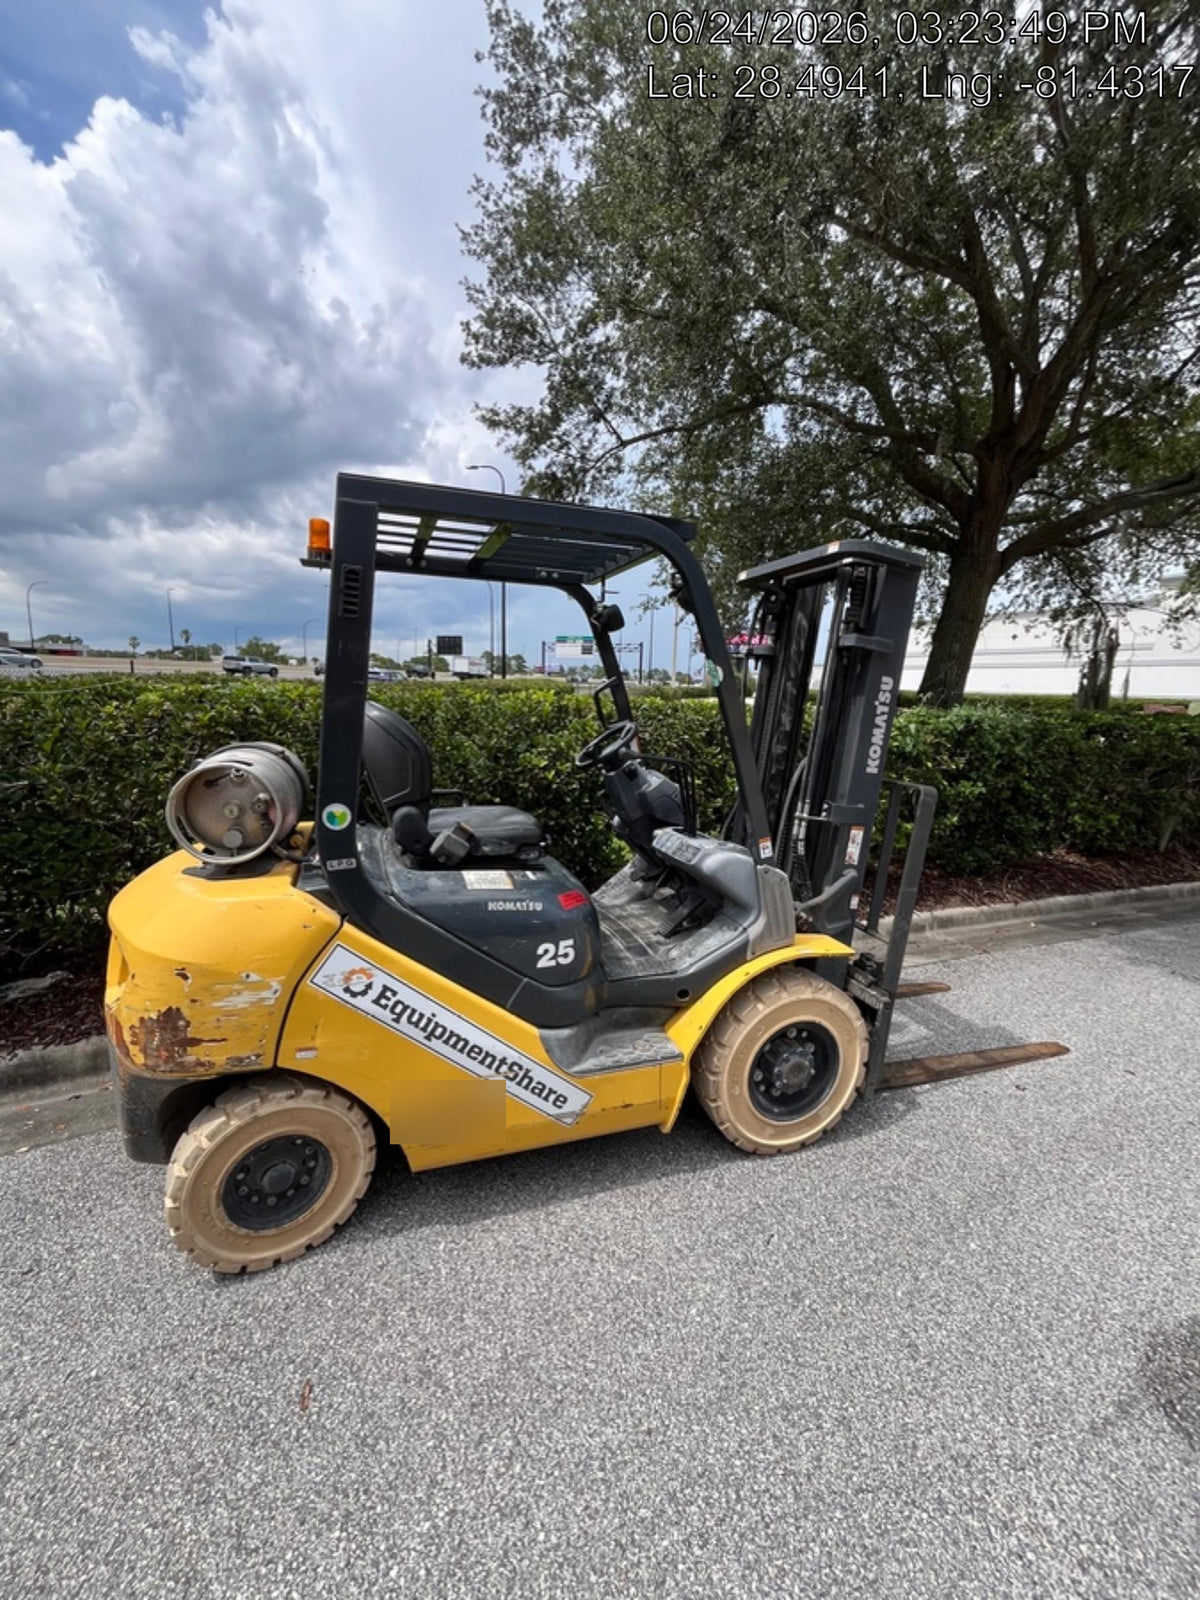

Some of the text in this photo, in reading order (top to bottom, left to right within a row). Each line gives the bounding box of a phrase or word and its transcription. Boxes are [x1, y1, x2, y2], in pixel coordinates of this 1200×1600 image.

[865, 675, 894, 774] KOMATSU
[487, 899, 543, 911] KOMATSU
[536, 938, 575, 968] 25
[371, 984, 568, 1109] EquipmentShare
